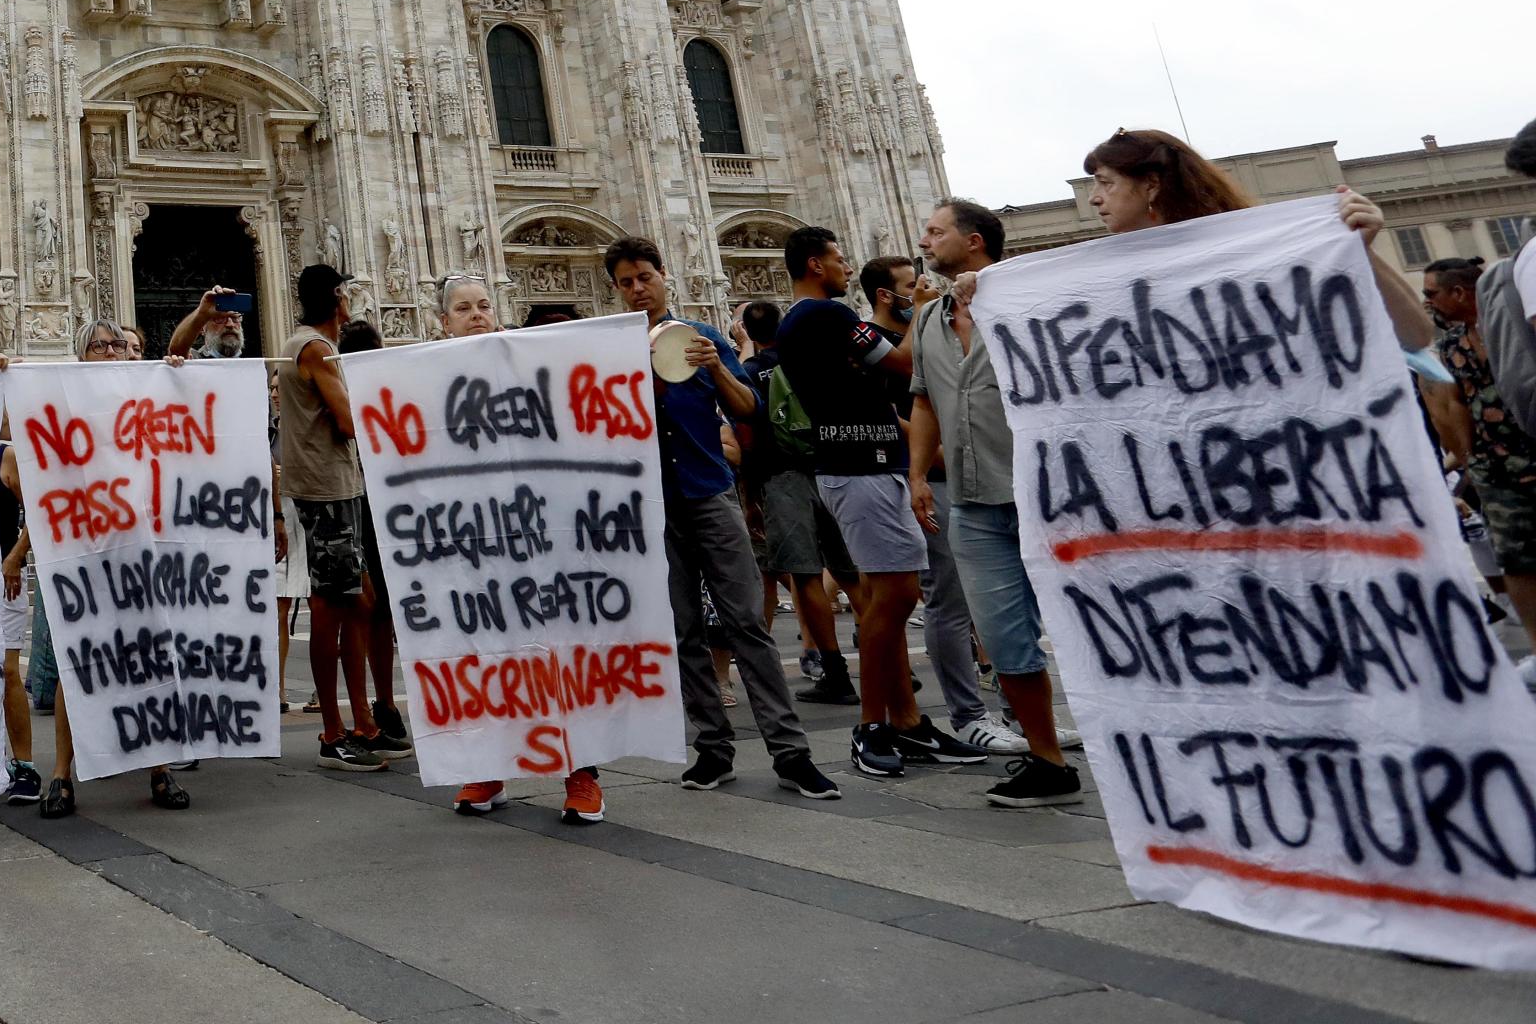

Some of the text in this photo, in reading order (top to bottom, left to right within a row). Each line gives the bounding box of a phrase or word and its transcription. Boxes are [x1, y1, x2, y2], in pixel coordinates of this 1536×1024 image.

[992, 264, 1366, 408] DIFENDIAMO
[25, 392, 217, 470] NO GREEN
[361, 363, 653, 456] NO GREEN PASS
[173, 476, 269, 539] LIBERI
[385, 484, 647, 569] SCEGLIERE NON
[1036, 438, 1115, 534] LA
[52, 566, 98, 622] DI
[245, 569, 269, 613] E
[450, 579, 507, 634] UN
[511, 571, 631, 631] REATO
[1062, 568, 1496, 705] DIFENDIAMO
[516, 726, 573, 773] SI
[1115, 731, 1536, 880] IL FUTURO
